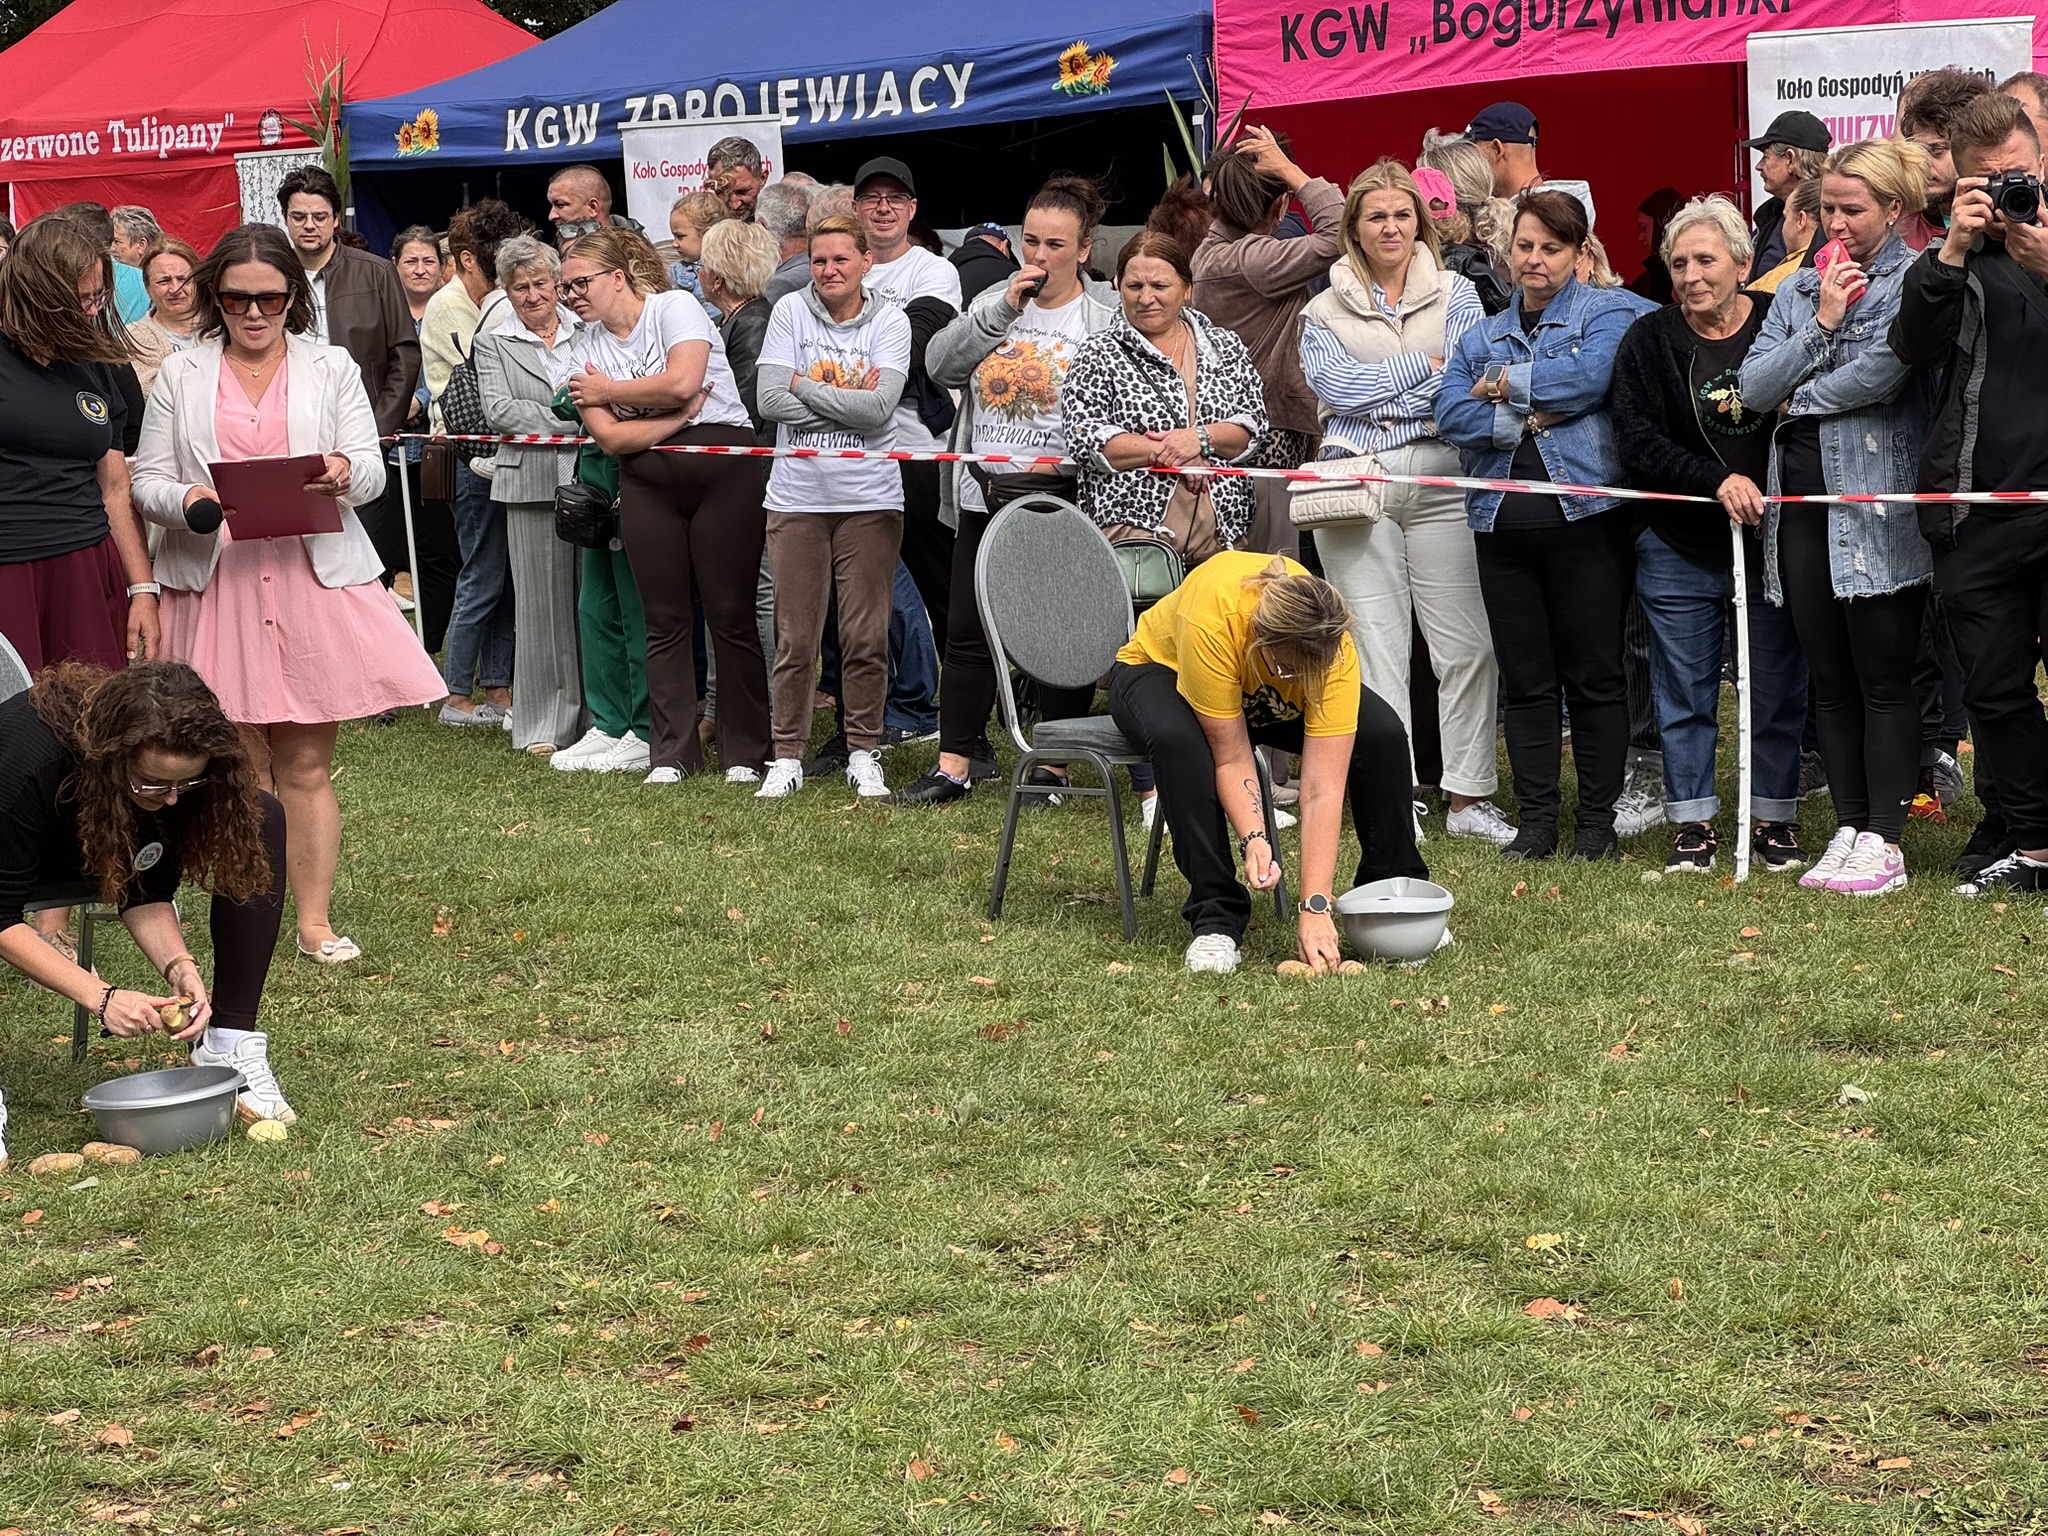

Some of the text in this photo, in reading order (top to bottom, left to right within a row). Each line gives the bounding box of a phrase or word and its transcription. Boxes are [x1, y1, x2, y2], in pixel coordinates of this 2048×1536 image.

[1281, 1, 1389, 63] KGW
[504, 62, 975, 153] KGW ZDROJEWIACY
[1777, 77, 1812, 101] Koło
[1818, 69, 1903, 101] Gospodyń
[1, 130, 99, 163] zerwone
[107, 112, 234, 160] Tulipany"
[633, 158, 708, 181] Koło Gospody
